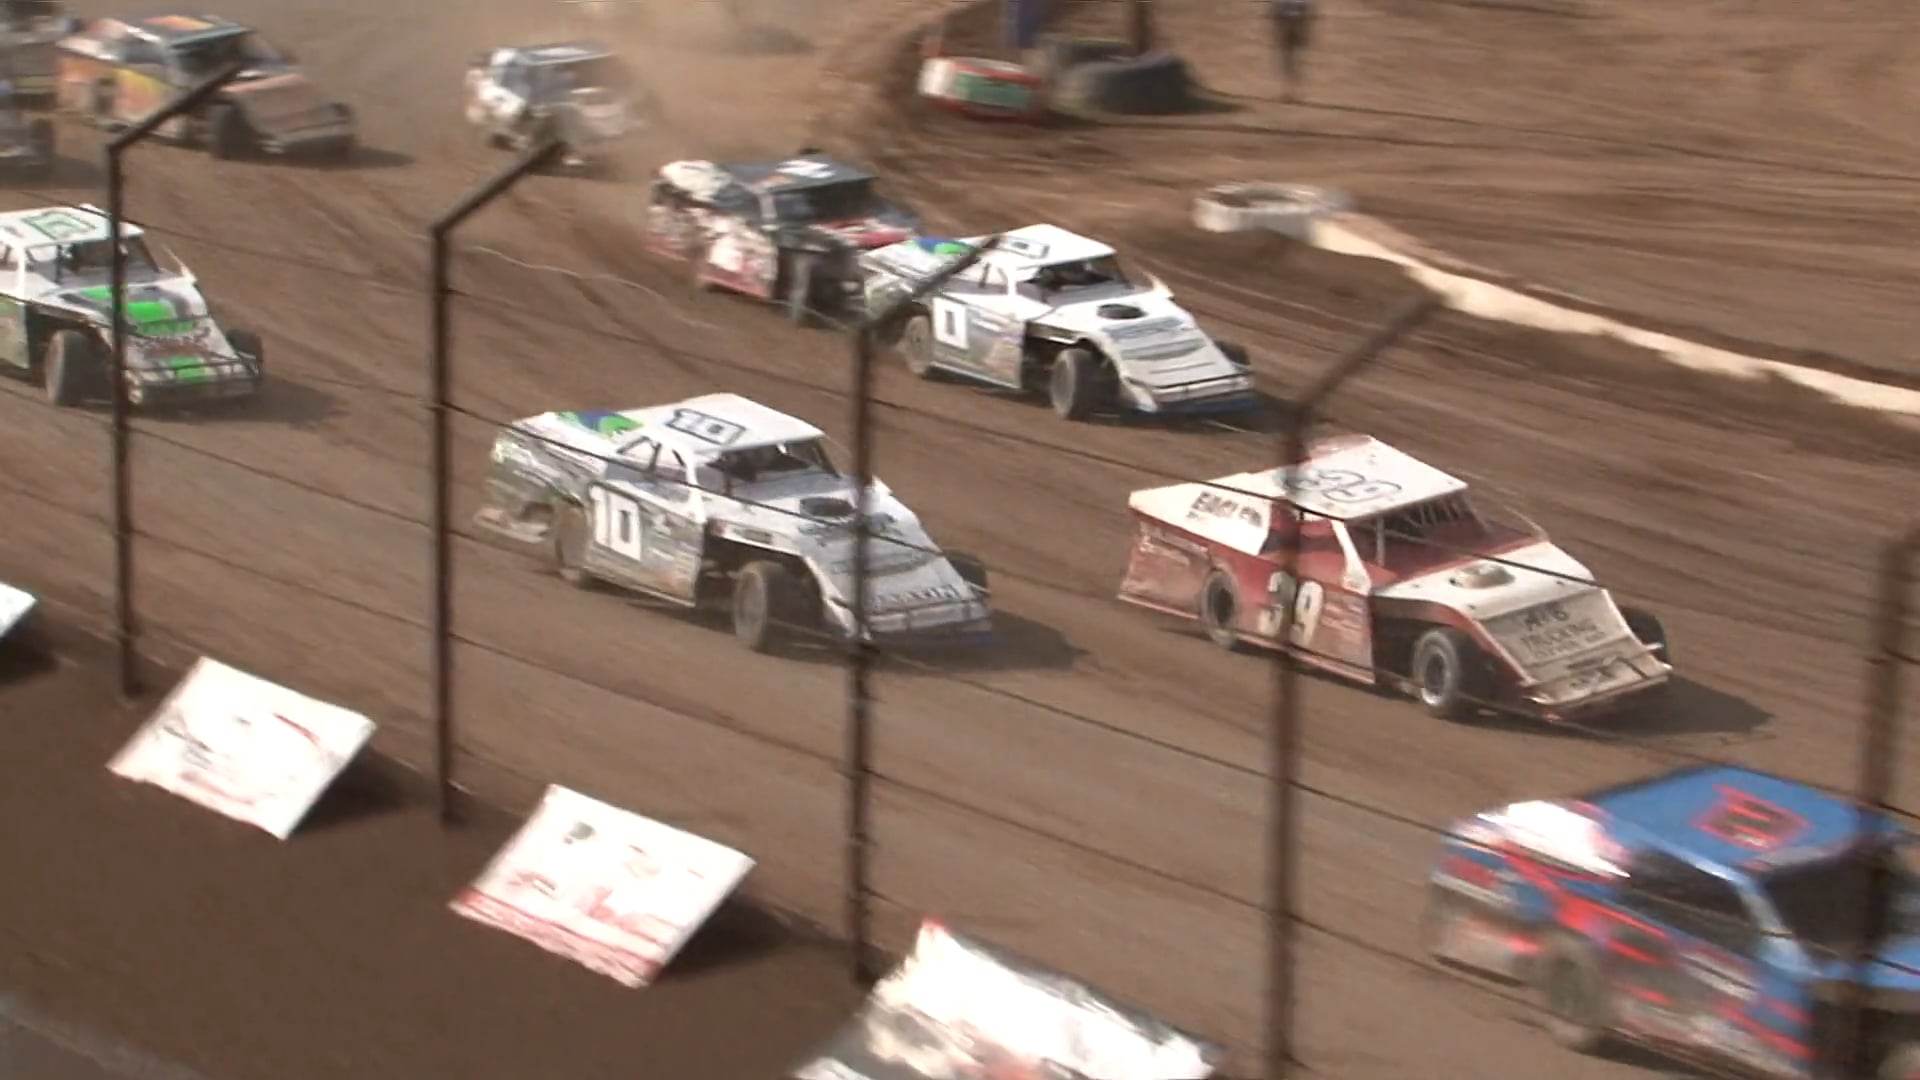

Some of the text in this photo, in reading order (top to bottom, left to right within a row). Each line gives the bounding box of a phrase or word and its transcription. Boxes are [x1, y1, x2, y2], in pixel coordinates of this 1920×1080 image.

[665, 408, 747, 446] 10
[588, 483, 641, 561] 10
[1257, 571, 1324, 648] 39
